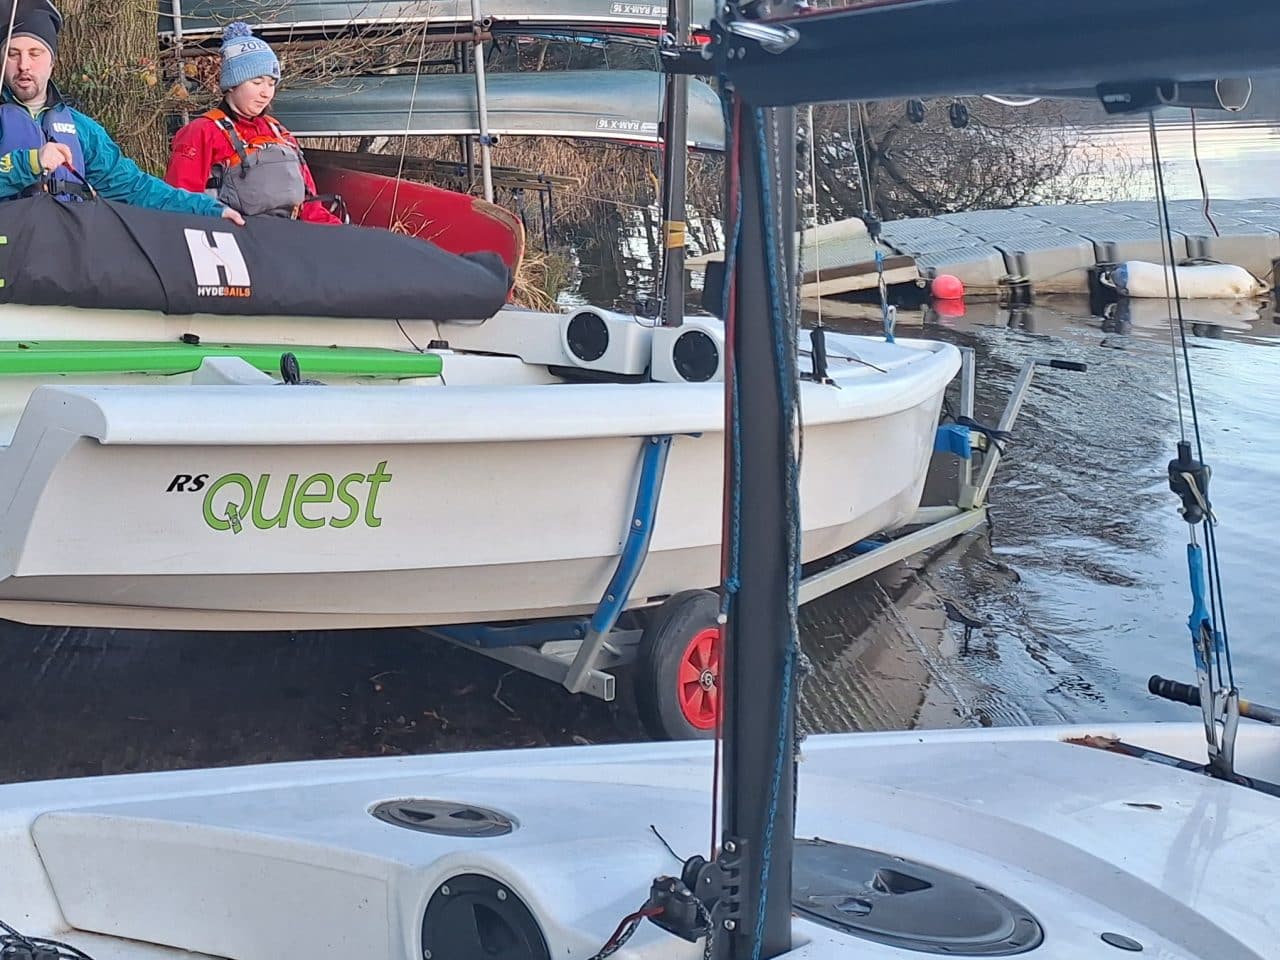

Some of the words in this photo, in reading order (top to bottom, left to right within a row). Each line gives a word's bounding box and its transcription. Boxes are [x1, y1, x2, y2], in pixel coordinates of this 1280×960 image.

[197, 286, 251, 297] HYDESAILS
[166, 474, 209, 492] RS
[202, 460, 392, 534] Quest
